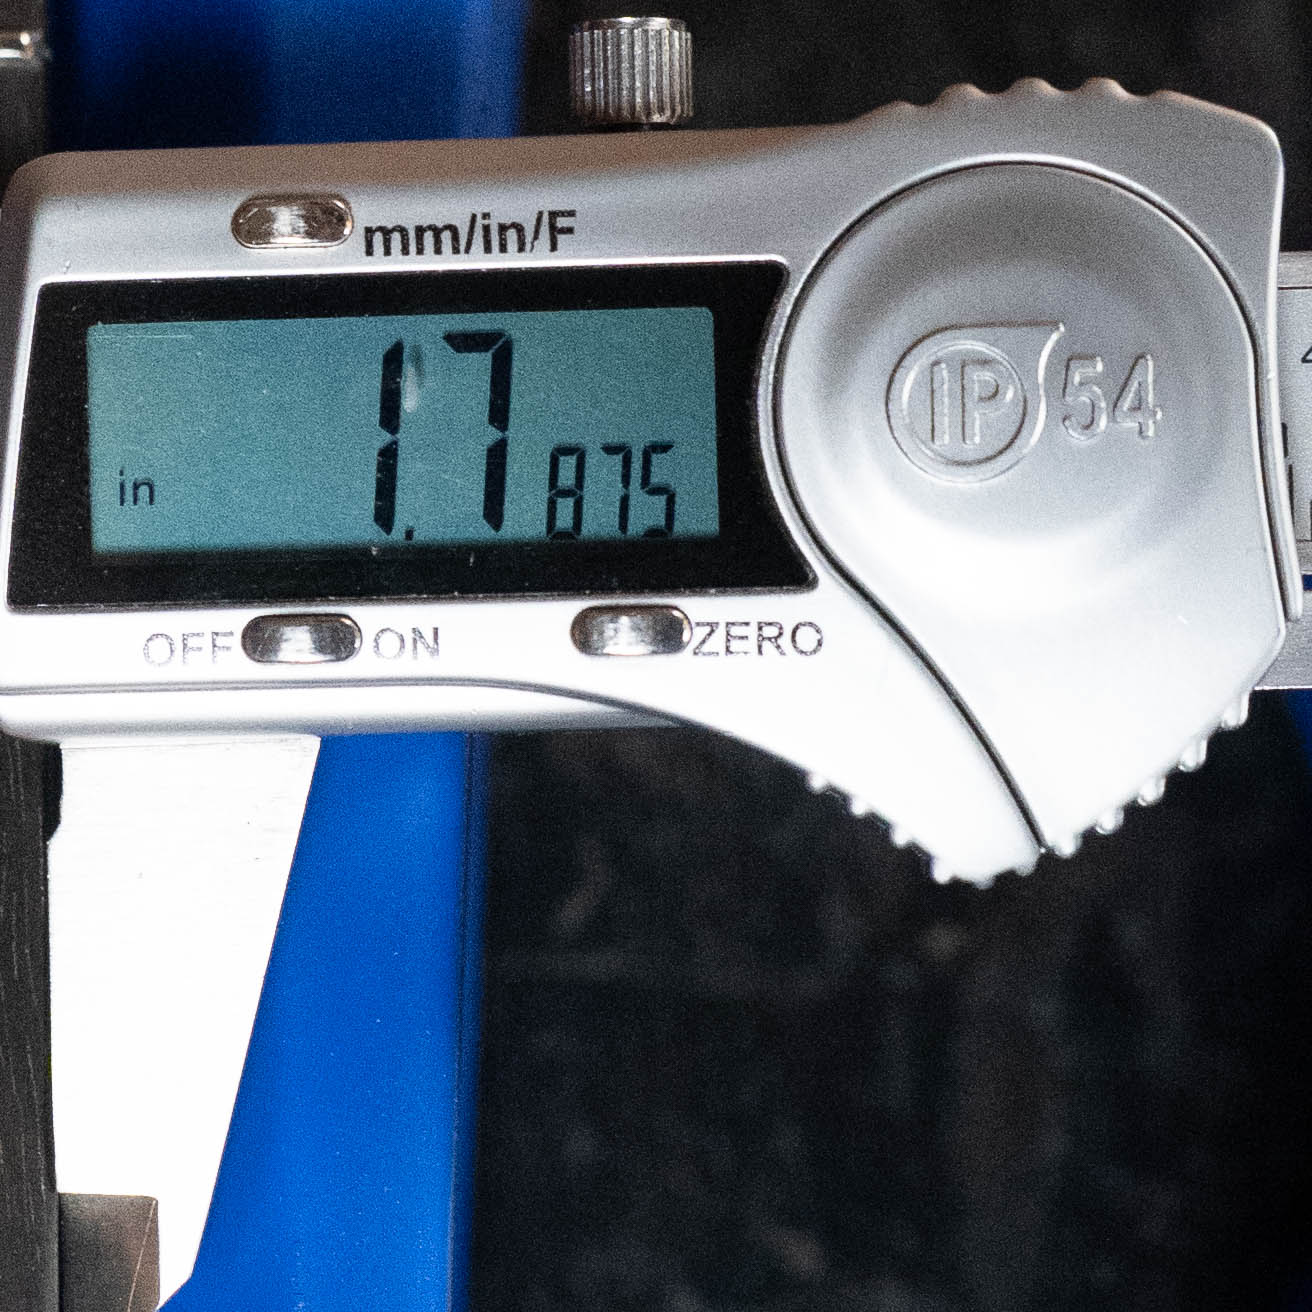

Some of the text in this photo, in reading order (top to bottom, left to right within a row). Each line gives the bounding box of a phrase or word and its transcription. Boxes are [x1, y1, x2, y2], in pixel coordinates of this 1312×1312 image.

[364, 210, 578, 258] mm/in/F
[929, 353, 1162, 446] IP 54
[118, 469, 155, 507] in
[142, 627, 441, 668] OFF ON
[691, 621, 824, 658] ZERO
